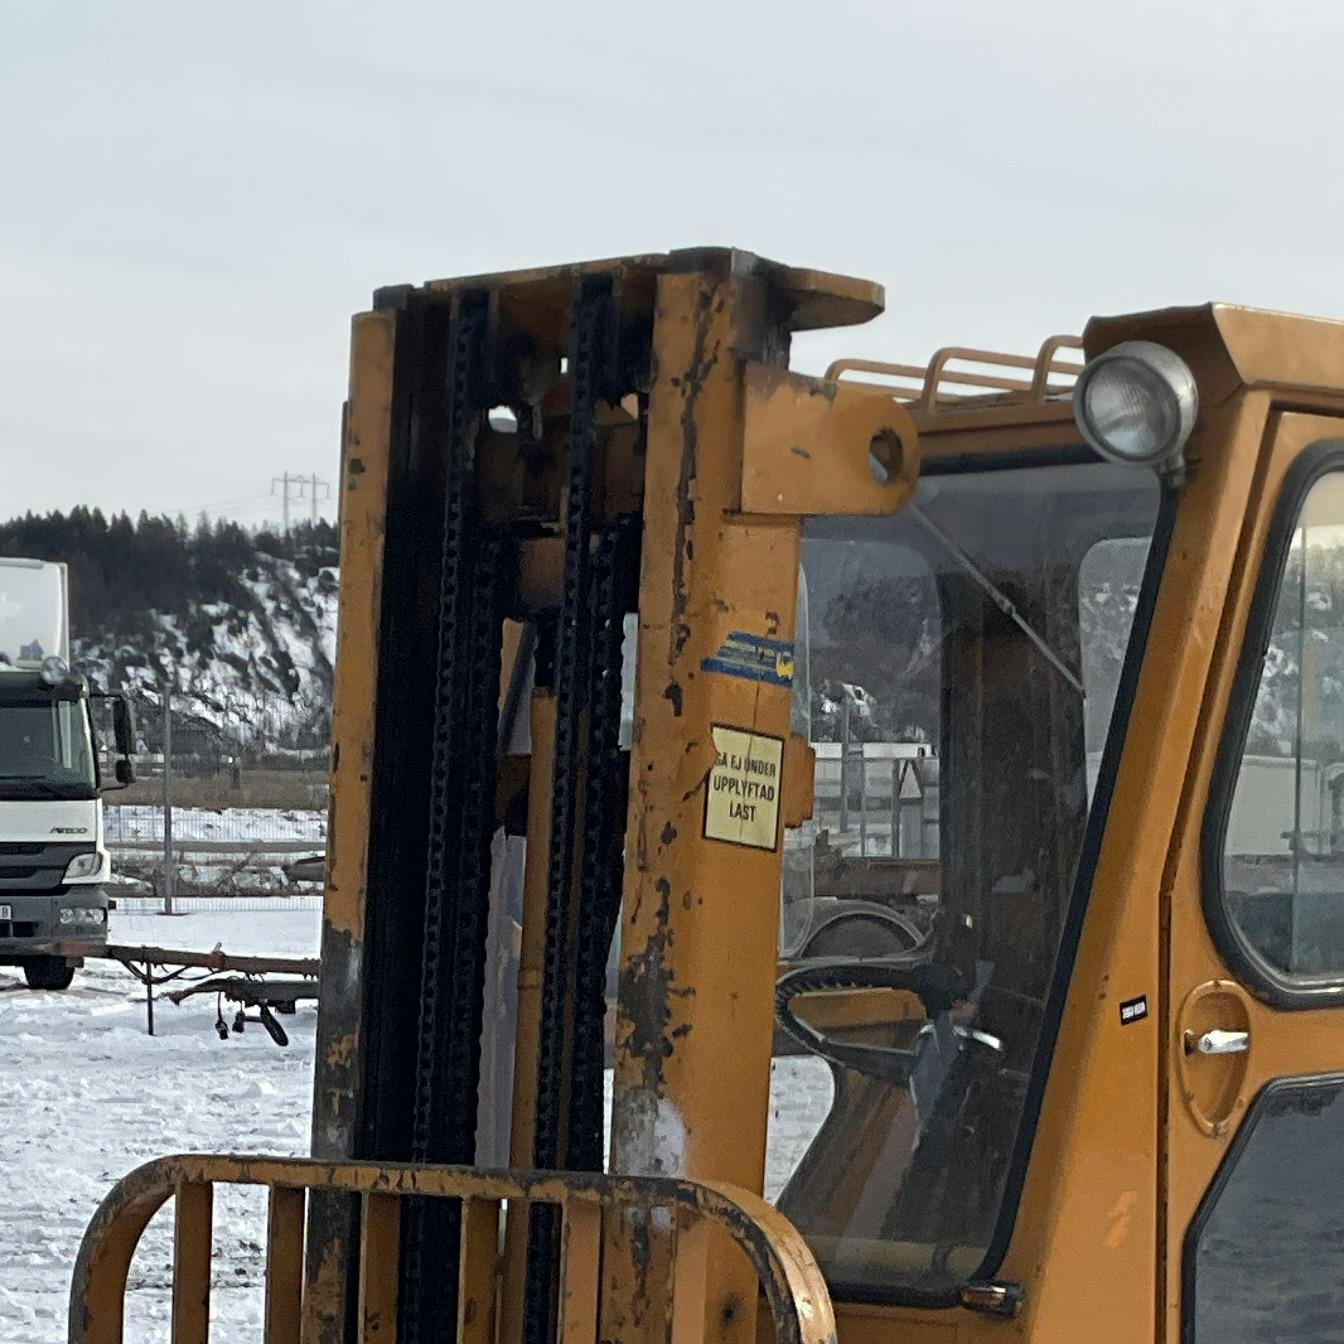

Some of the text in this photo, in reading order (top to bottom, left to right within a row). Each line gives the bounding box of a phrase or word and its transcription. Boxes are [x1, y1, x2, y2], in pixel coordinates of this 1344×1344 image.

[730, 755, 742, 771] EJ
[744, 757, 776, 777] UNDER
[713, 775, 775, 801] UPPLYFTAD
[729, 800, 756, 822] LAST
